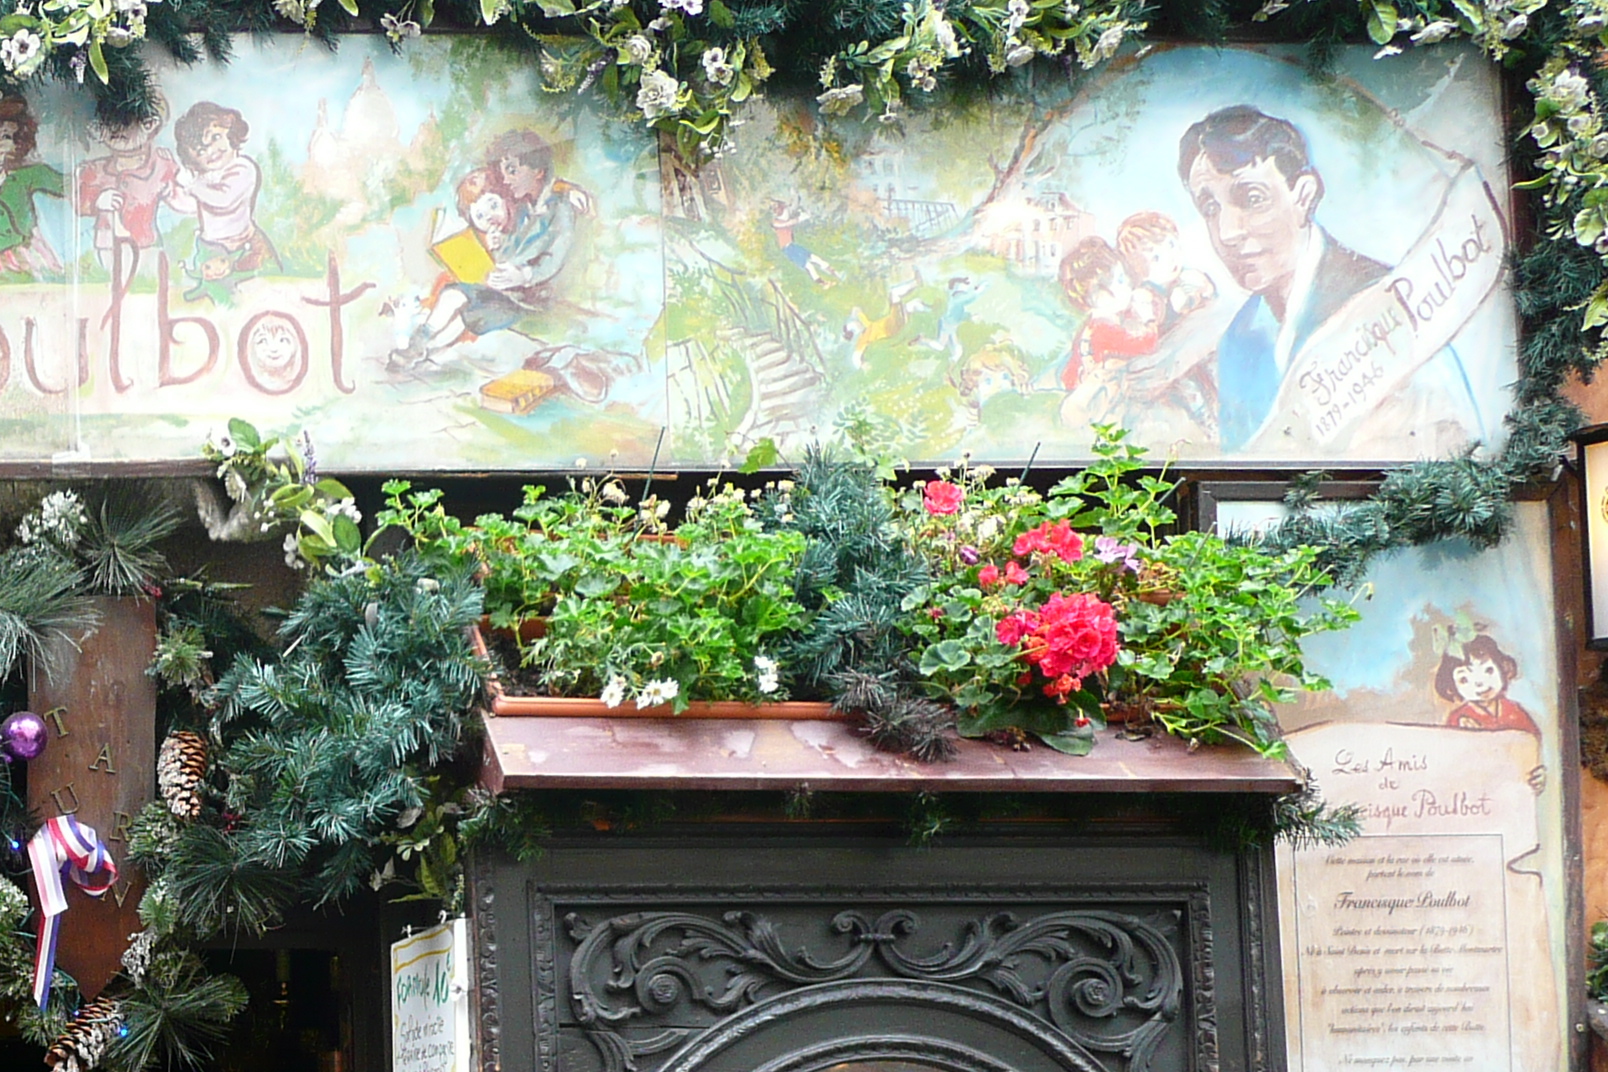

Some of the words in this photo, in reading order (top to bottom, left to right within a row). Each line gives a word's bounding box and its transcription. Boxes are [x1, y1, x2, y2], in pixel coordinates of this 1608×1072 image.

[1299, 307, 1402, 406] Francisque
[1385, 214, 1492, 333] Poulbot
[1316, 360, 1385, 437] 1879-1946
[1332, 749, 1369, 774] Les
[1373, 747, 1428, 771] Amis
[1378, 777, 1399, 789] de
[1411, 788, 1493, 818] Poulbot
[1334, 891, 1413, 915] Francisque
[1416, 890, 1470, 908] Poulbot
